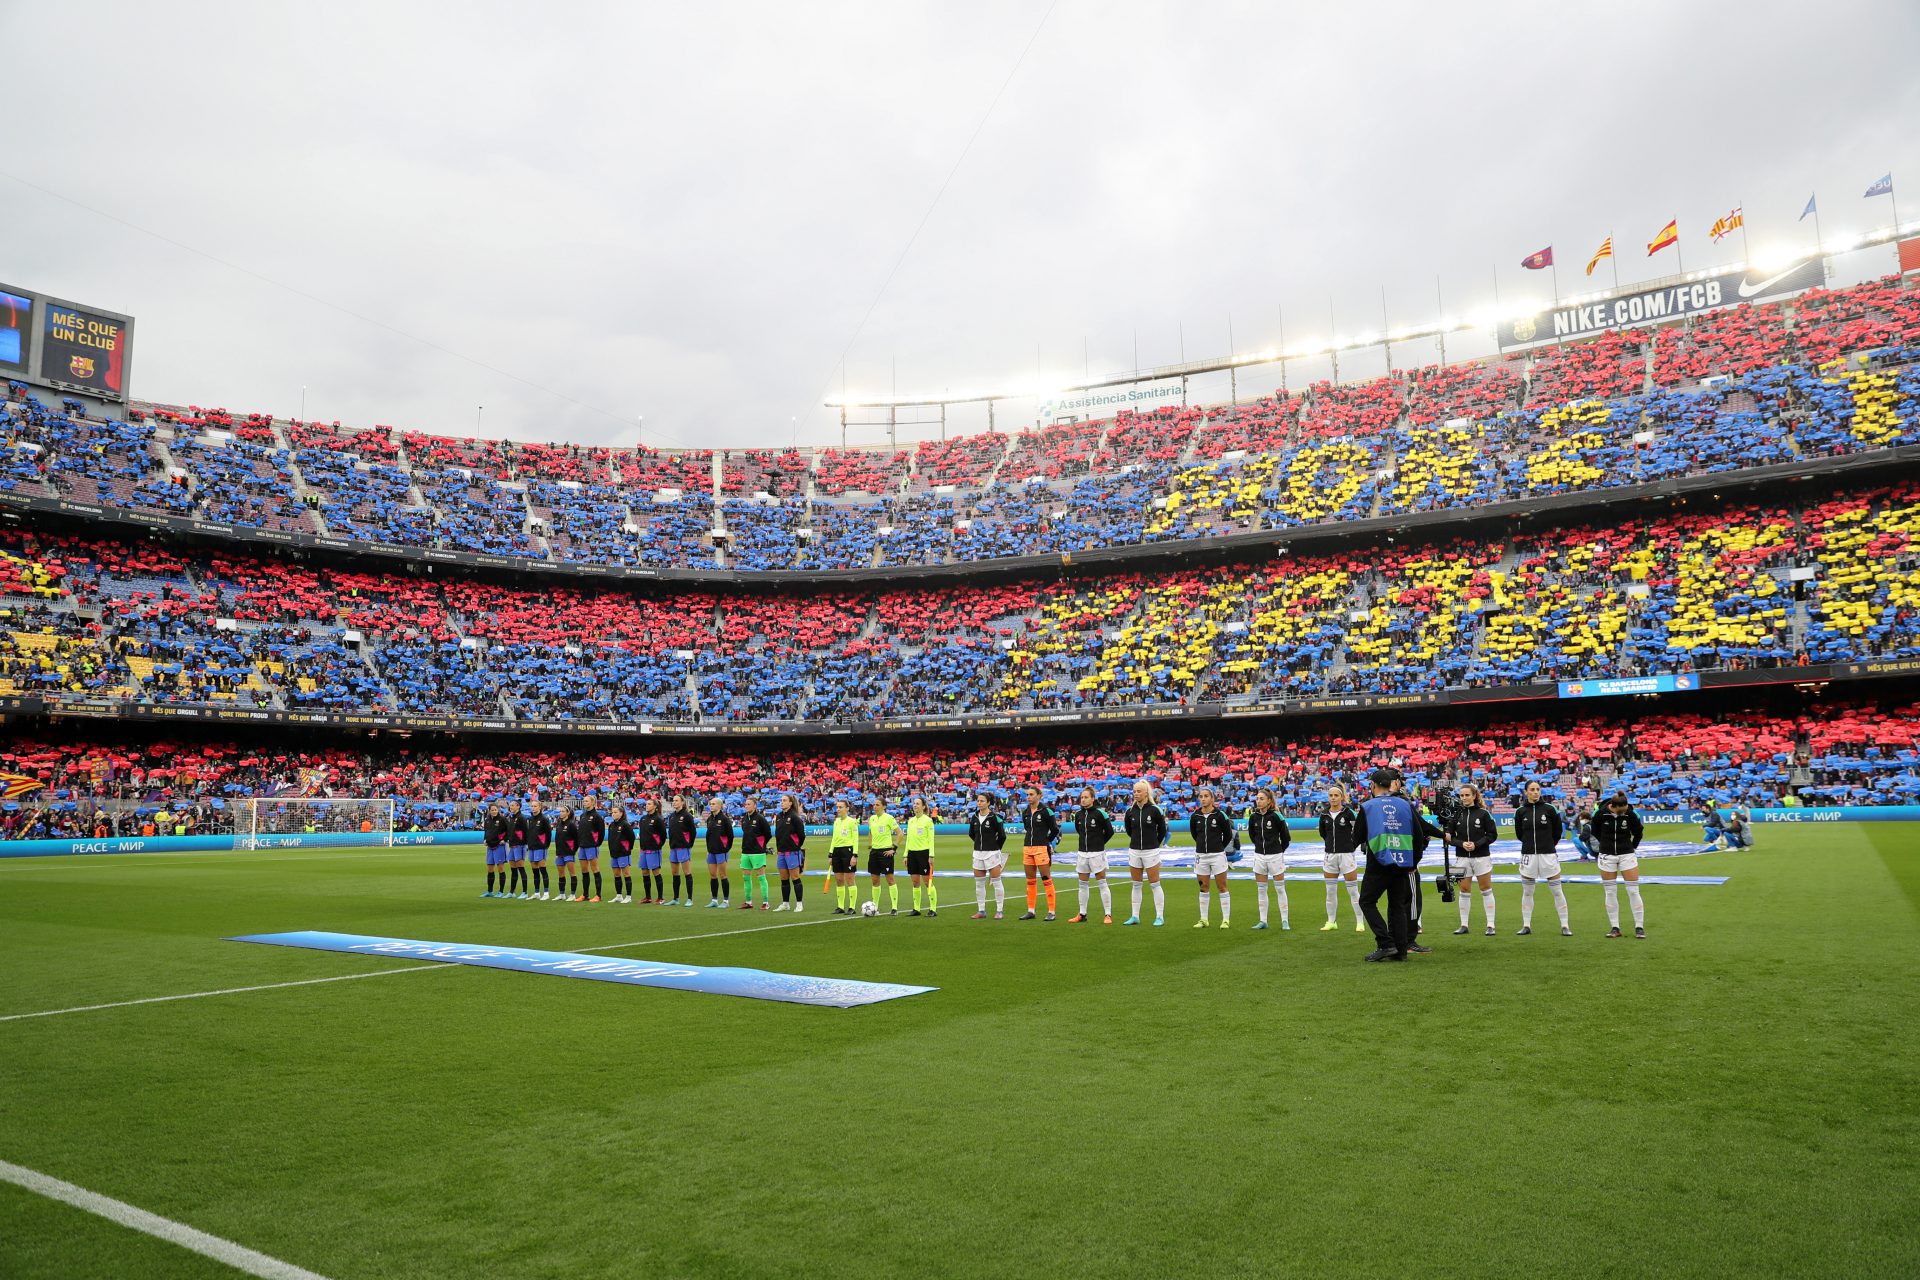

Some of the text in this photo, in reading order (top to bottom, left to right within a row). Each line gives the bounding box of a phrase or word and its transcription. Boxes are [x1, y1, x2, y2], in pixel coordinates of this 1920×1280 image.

[1553, 279, 1722, 336] NIKE.COM/FCB
[52, 312, 118, 338] MÉS QUE
[53, 327, 116, 351] UN CLUB
[1058, 385, 1182, 411] Assistència Sanitària
[75, 505, 103, 514] BARCELONA
[207, 525, 233, 533] BARCELONA
[1867, 664, 1882, 672] MÉS
[1882, 663, 1898, 671] QUE
[1899, 662, 1911, 670] UN
[1609, 679, 1658, 688] BARCELONA
[1601, 685, 1657, 694] REAL MADRID
[1377, 697, 1387, 705] MÉS
[176, 708, 199, 716] ORGULL
[1643, 814, 1684, 824] LEAGUE
[1765, 812, 1802, 821] PEACE
[1813, 811, 1841, 820] МИР
[281, 838, 302, 846] МИР
[415, 835, 434, 844] МИР
[1387, 836, 1401, 847] HB
[72, 842, 108, 854] PEACE
[119, 841, 145, 852] МИР
[348, 942, 520, 960] PEACE
